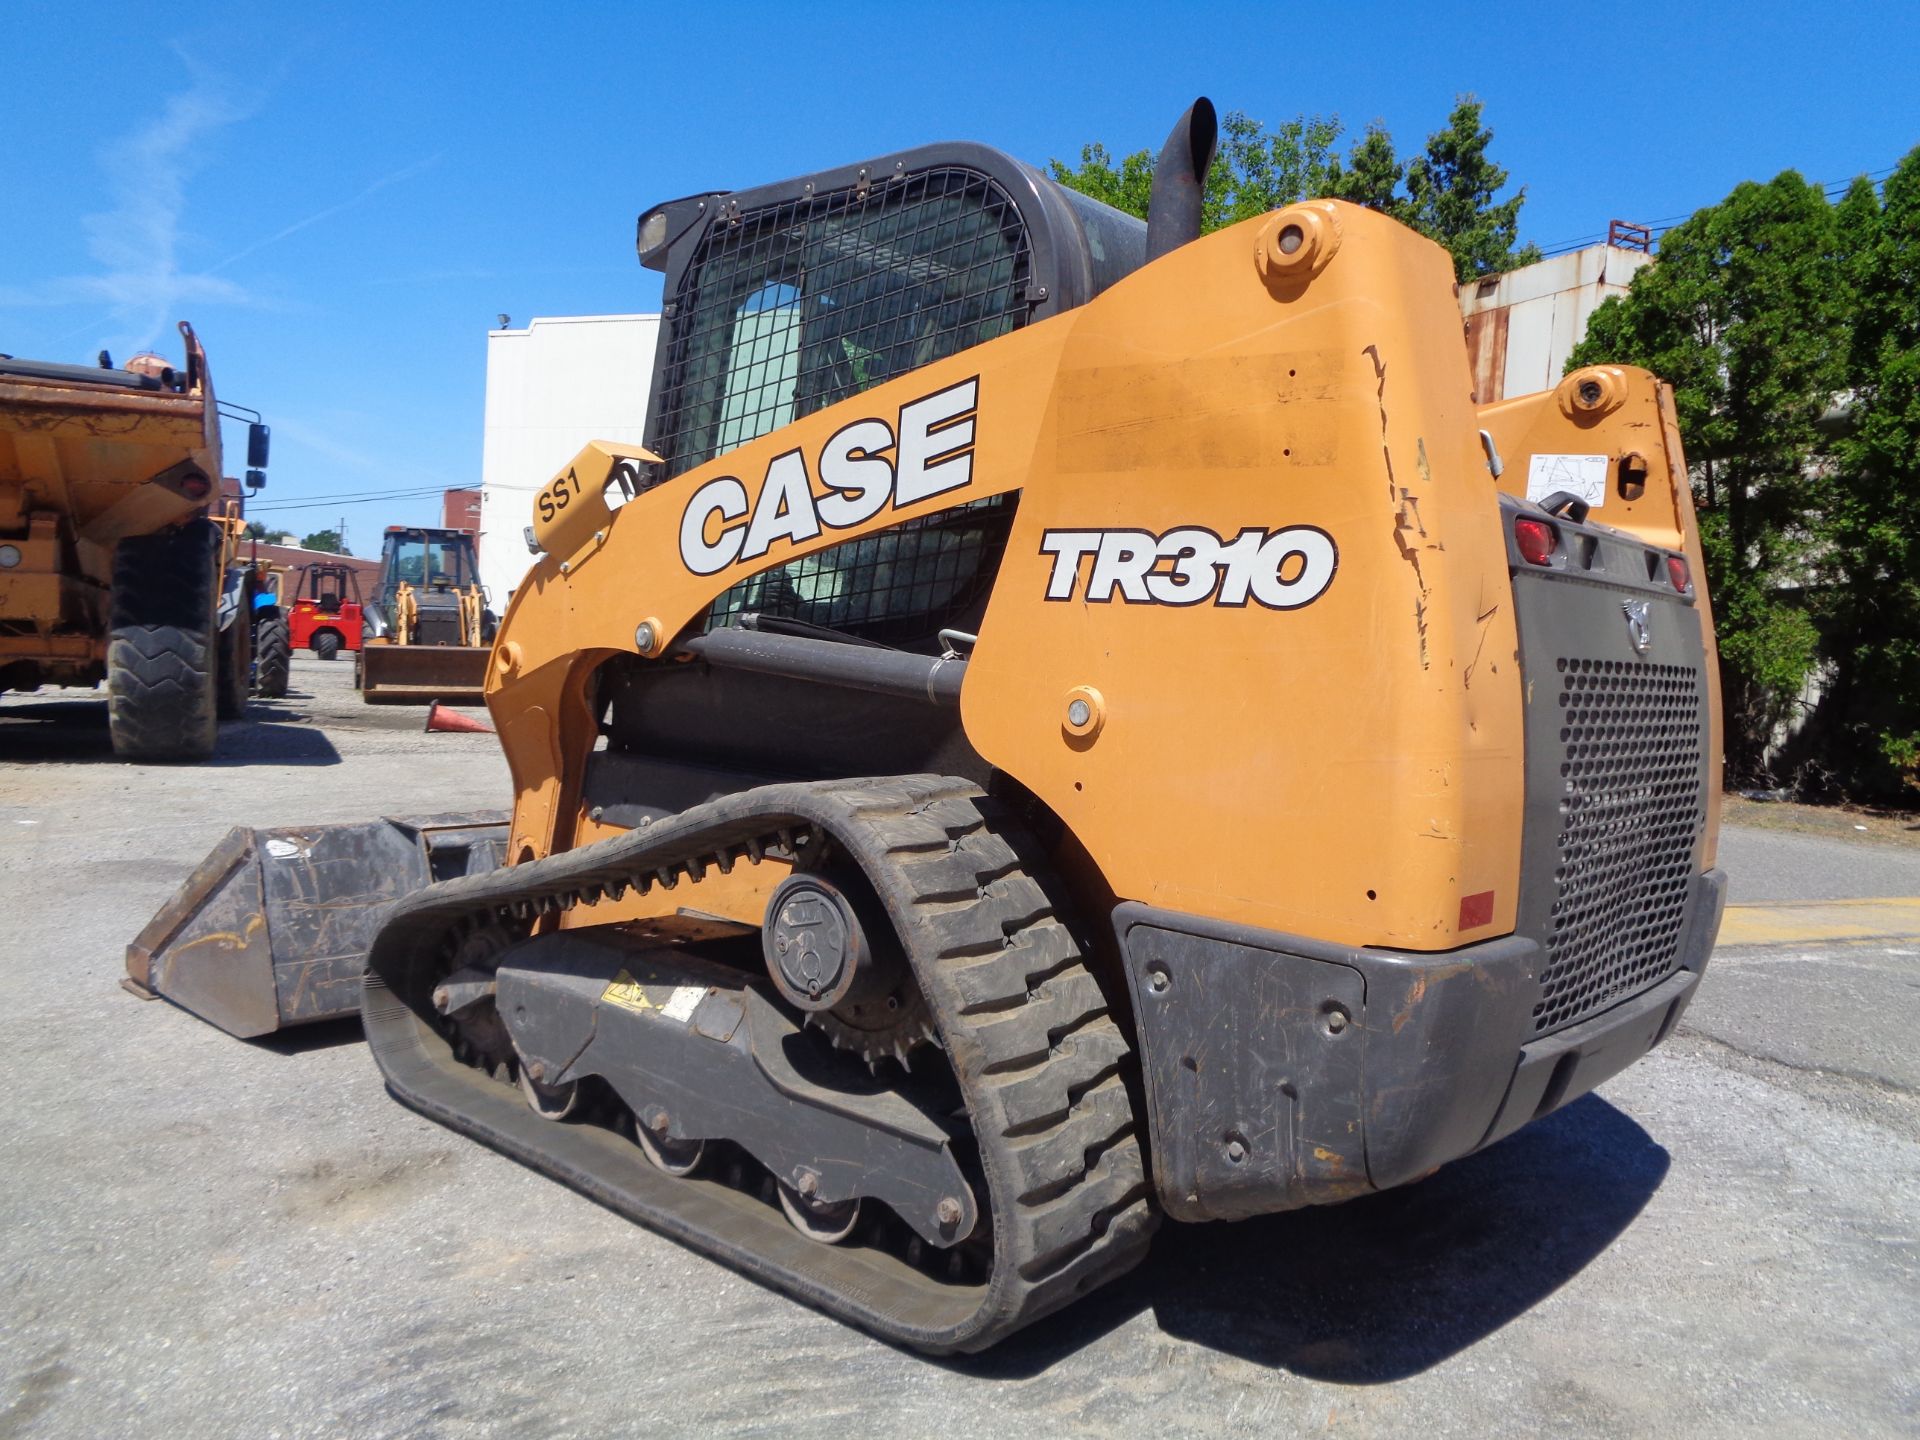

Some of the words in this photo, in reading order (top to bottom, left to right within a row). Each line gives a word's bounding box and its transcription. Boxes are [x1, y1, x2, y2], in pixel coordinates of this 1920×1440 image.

[539, 466, 580, 523] SS1
[679, 374, 980, 577] CASE
[1038, 524, 1339, 611] TR310
